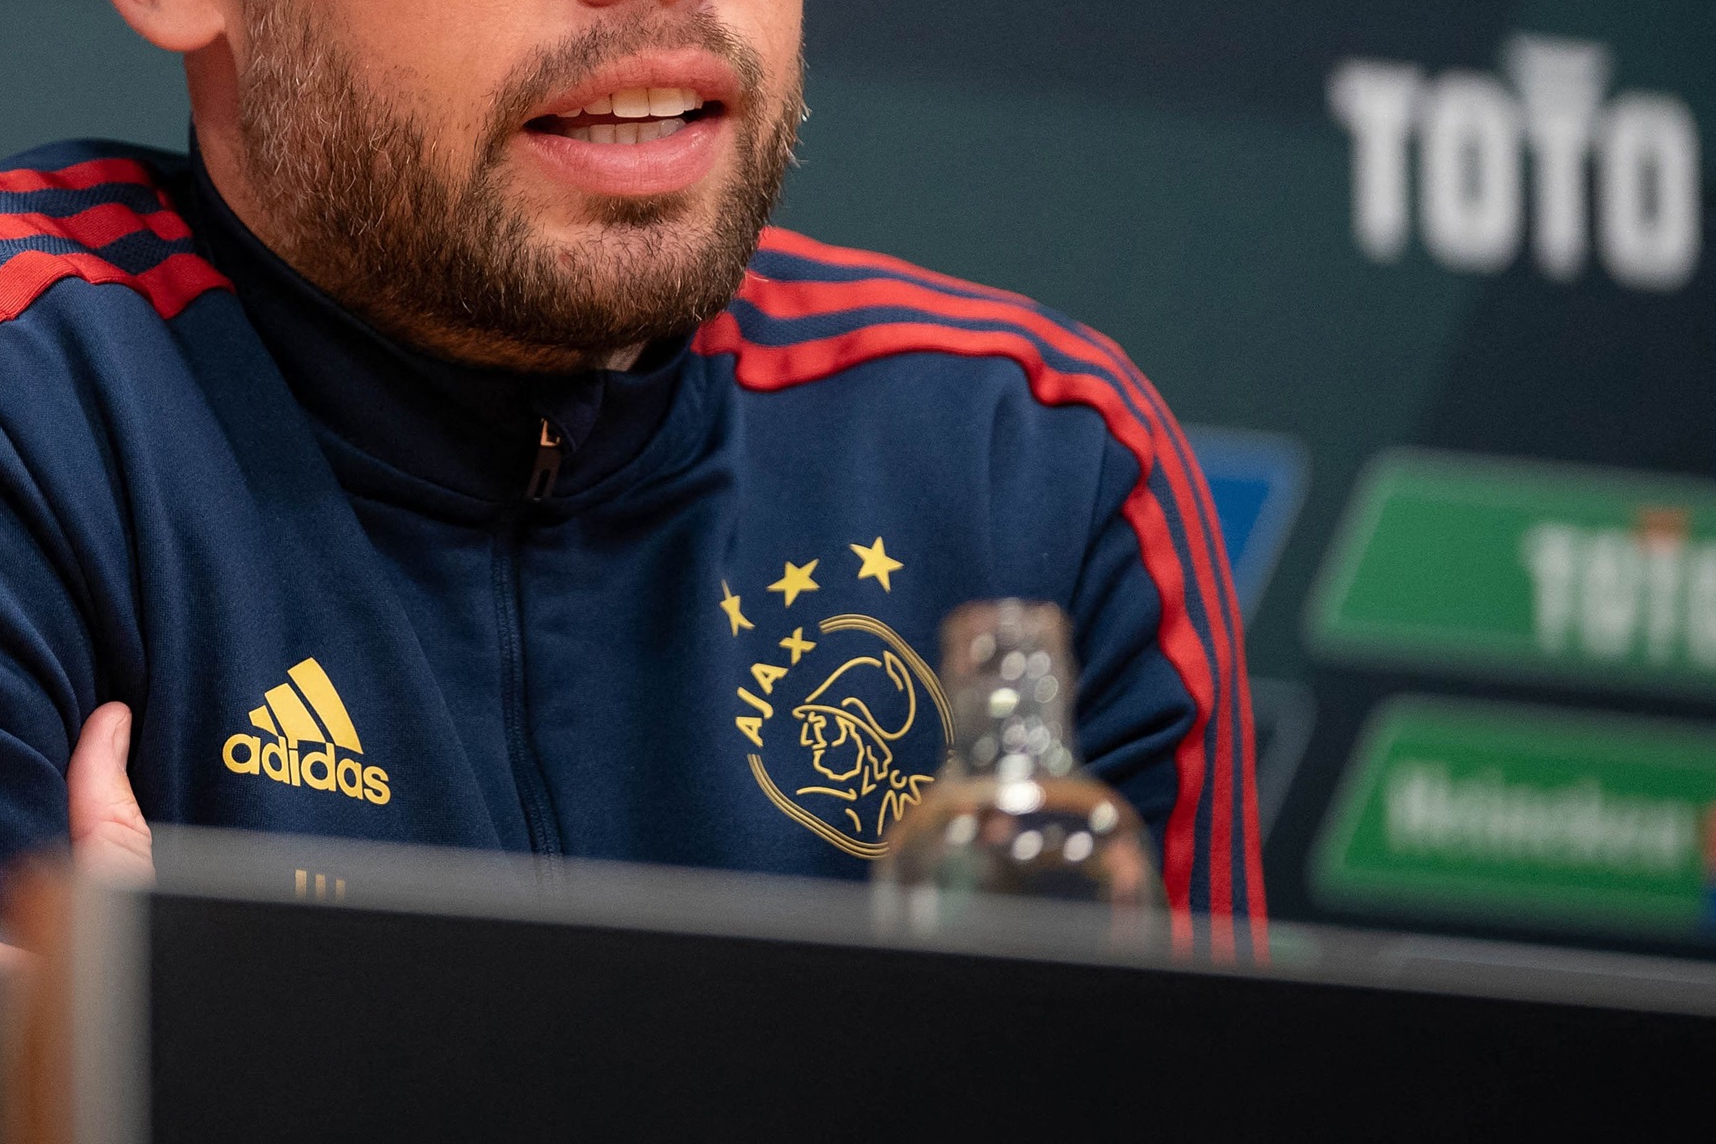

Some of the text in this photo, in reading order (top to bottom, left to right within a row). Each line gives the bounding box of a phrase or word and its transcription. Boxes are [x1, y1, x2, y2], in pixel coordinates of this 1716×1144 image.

[1326, 31, 1701, 291] TOTO
[735, 626, 817, 748] AJAX
[222, 732, 391, 805] adidas
